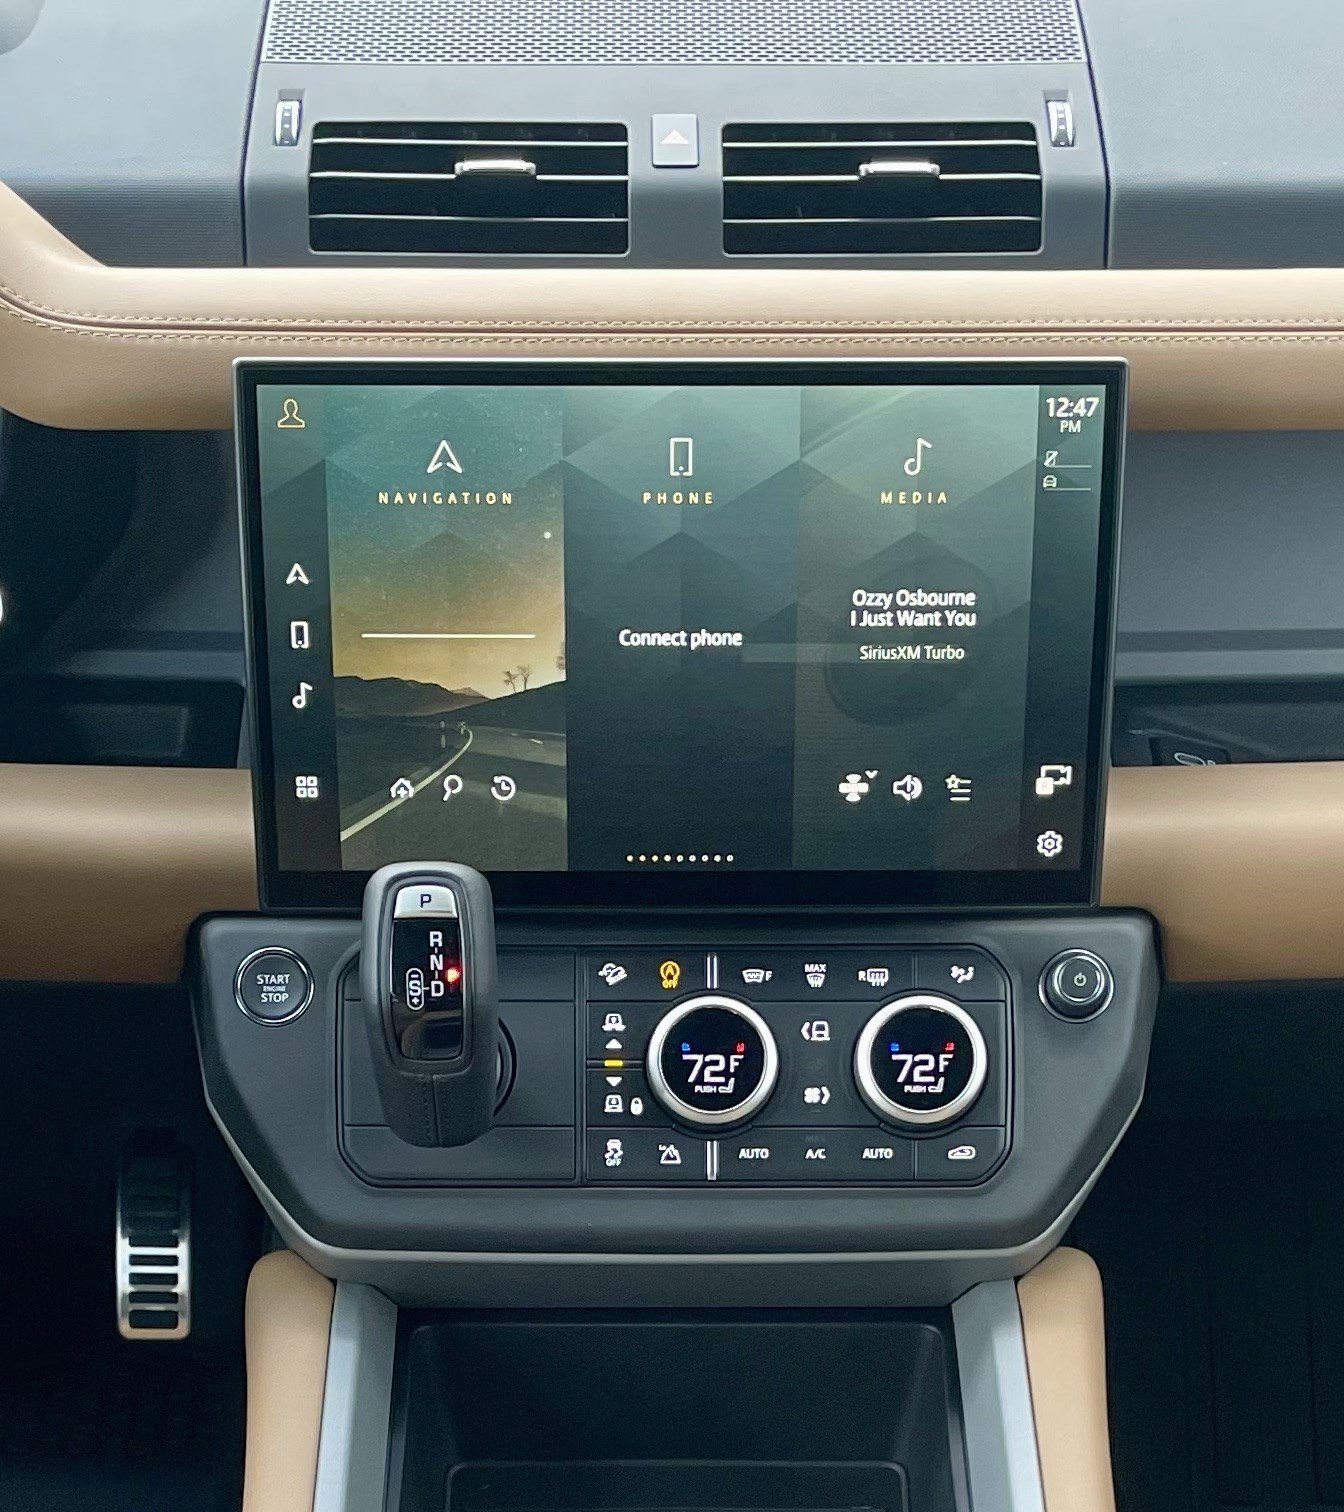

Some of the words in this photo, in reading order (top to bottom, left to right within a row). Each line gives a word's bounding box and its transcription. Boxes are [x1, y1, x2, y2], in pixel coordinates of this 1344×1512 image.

[1045, 397, 1099, 418] 12:47
[1060, 420, 1082, 433] PM
[378, 491, 513, 505] NAVIGATION
[643, 491, 713, 504] PHONE
[880, 491, 947, 504] MEDIA
[852, 588, 893, 609] Ozzy
[895, 588, 976, 606] Osbourne
[859, 610, 894, 627] Just
[896, 610, 943, 626] Want
[945, 610, 977, 627] You
[618, 628, 687, 647] Connect
[690, 628, 743, 651] phone
[859, 644, 920, 661] SiriusXM
[925, 644, 965, 660] Turbo
[420, 894, 432, 908] P
[429, 931, 443, 947] R
[430, 954, 443, 971] N
[805, 963, 827, 973] MAX
[256, 974, 290, 985] START
[765, 970, 773, 982] F
[858, 971, 866, 982] R
[408, 980, 421, 997] S
[431, 980, 444, 997] D
[661, 980, 678, 989] OFF
[260, 992, 289, 1003] STOP
[694, 1085, 717, 1094] PUSH
[903, 1085, 927, 1093] PUSH
[738, 1148, 770, 1160] AUTO
[805, 1148, 827, 1160] A/C
[862, 1148, 893, 1160] AUTO
[605, 1157, 622, 1167] OFF
